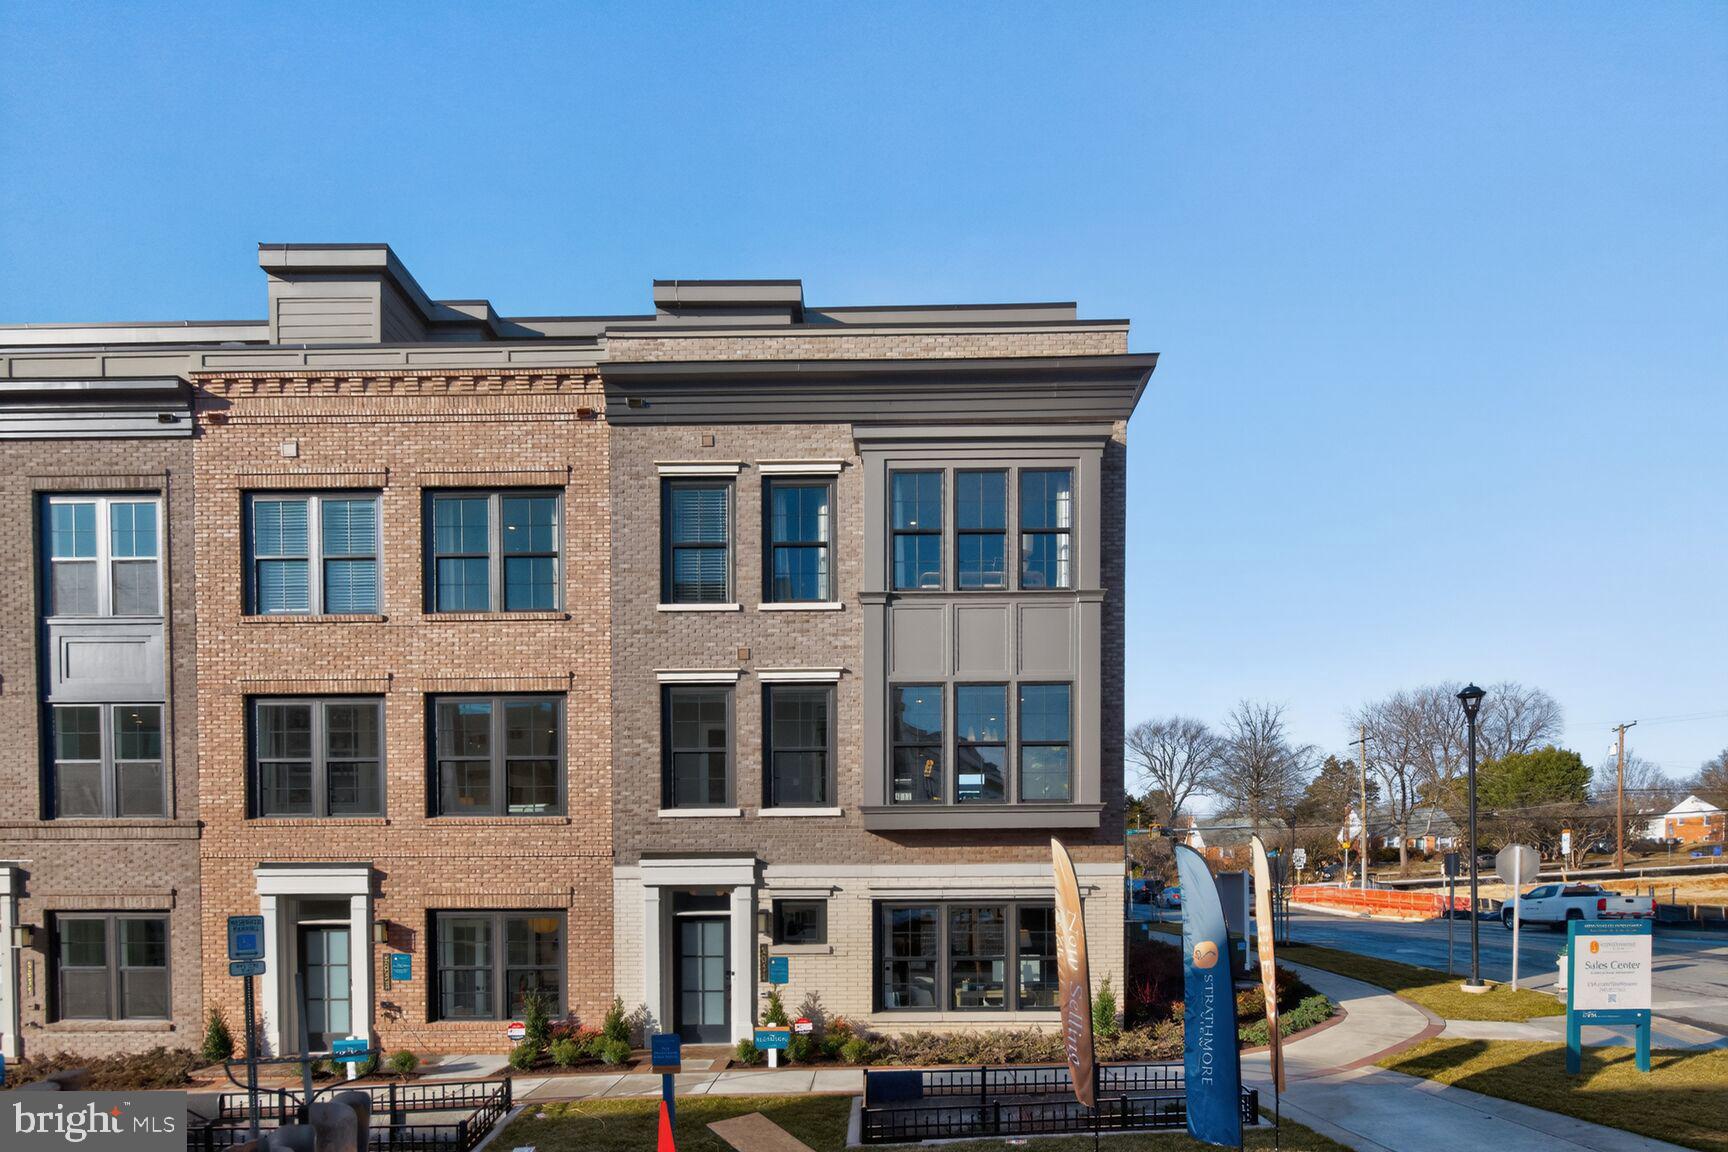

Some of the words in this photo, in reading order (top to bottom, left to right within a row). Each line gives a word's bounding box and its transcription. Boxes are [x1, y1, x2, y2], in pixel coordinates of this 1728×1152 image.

[1068, 911, 1078, 971] Now
[1585, 960, 1608, 970] Sales
[1610, 960, 1641, 970] Center
[1201, 974, 1214, 1086] STRATHMORE
